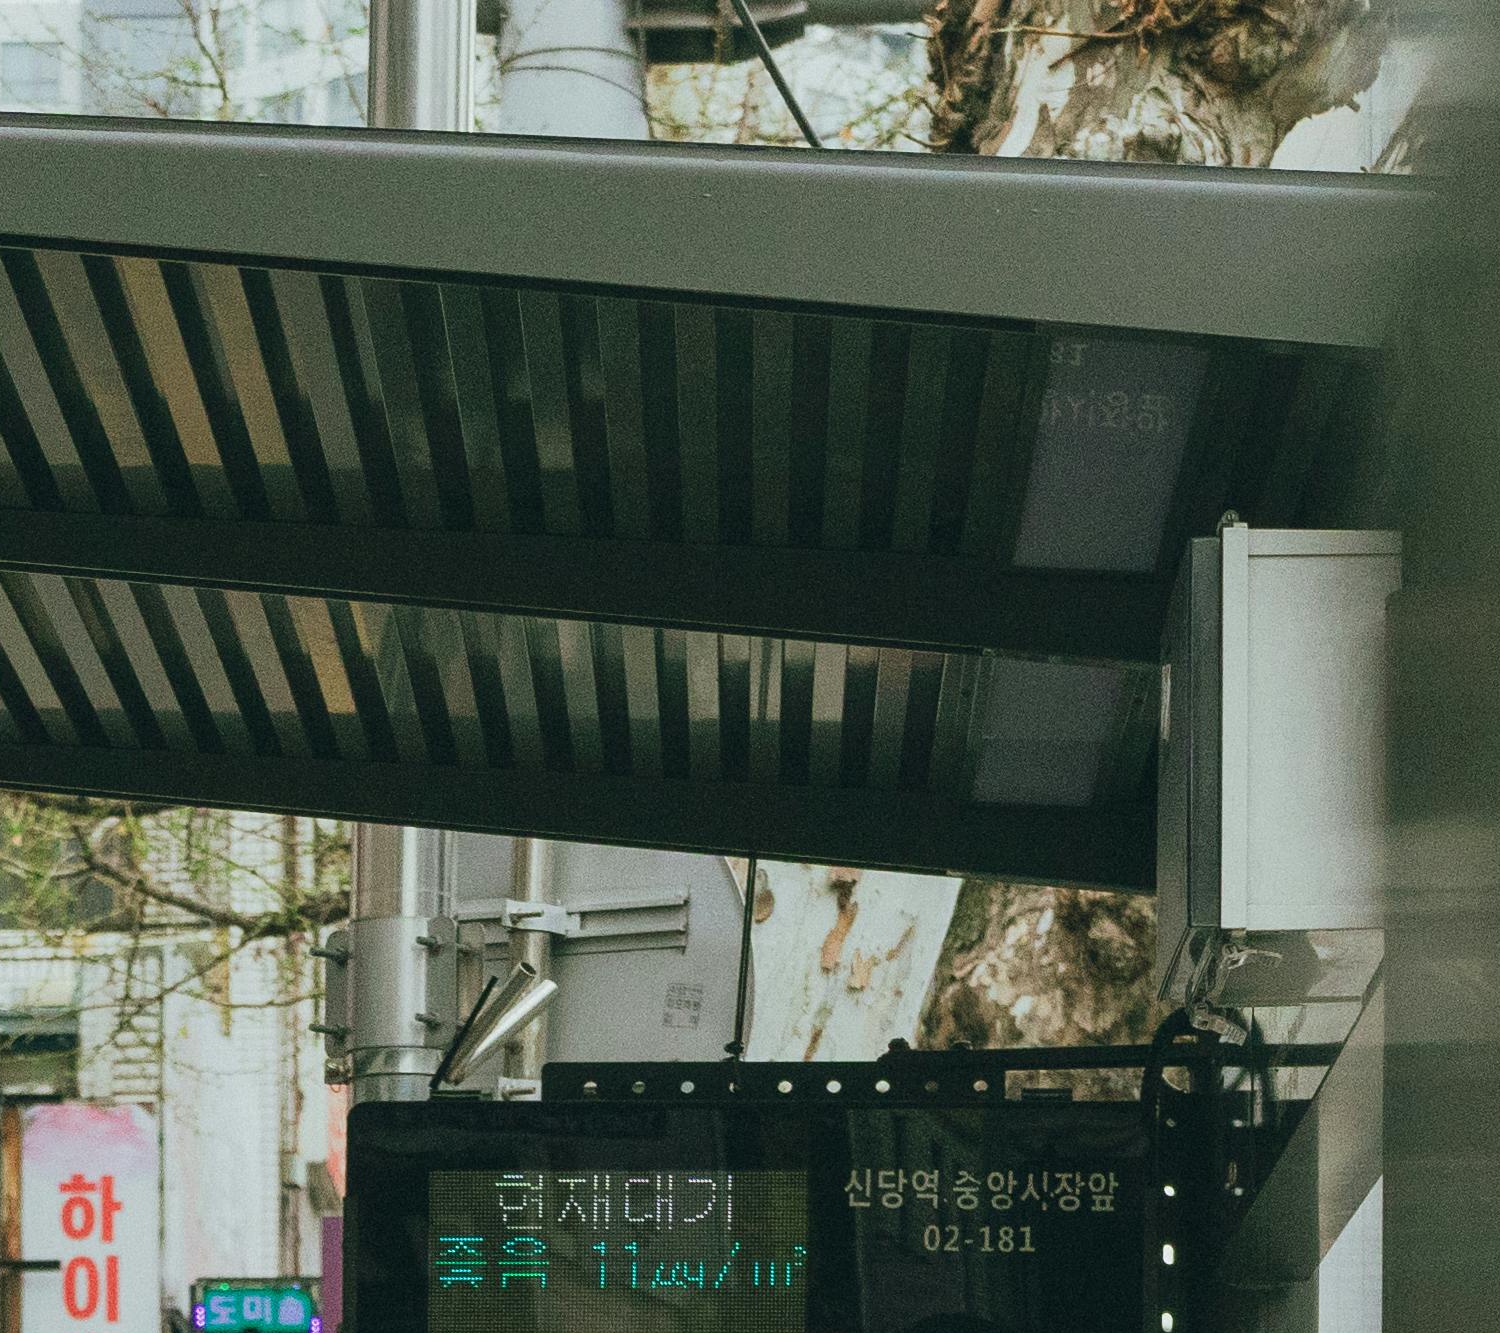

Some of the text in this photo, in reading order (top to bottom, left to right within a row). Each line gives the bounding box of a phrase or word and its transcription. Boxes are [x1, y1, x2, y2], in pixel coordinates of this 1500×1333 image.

[496, 1174, 733, 1231] 현재대기
[436, 1236, 550, 1288] 좋음
[924, 1225, 1036, 1252] 02-181
